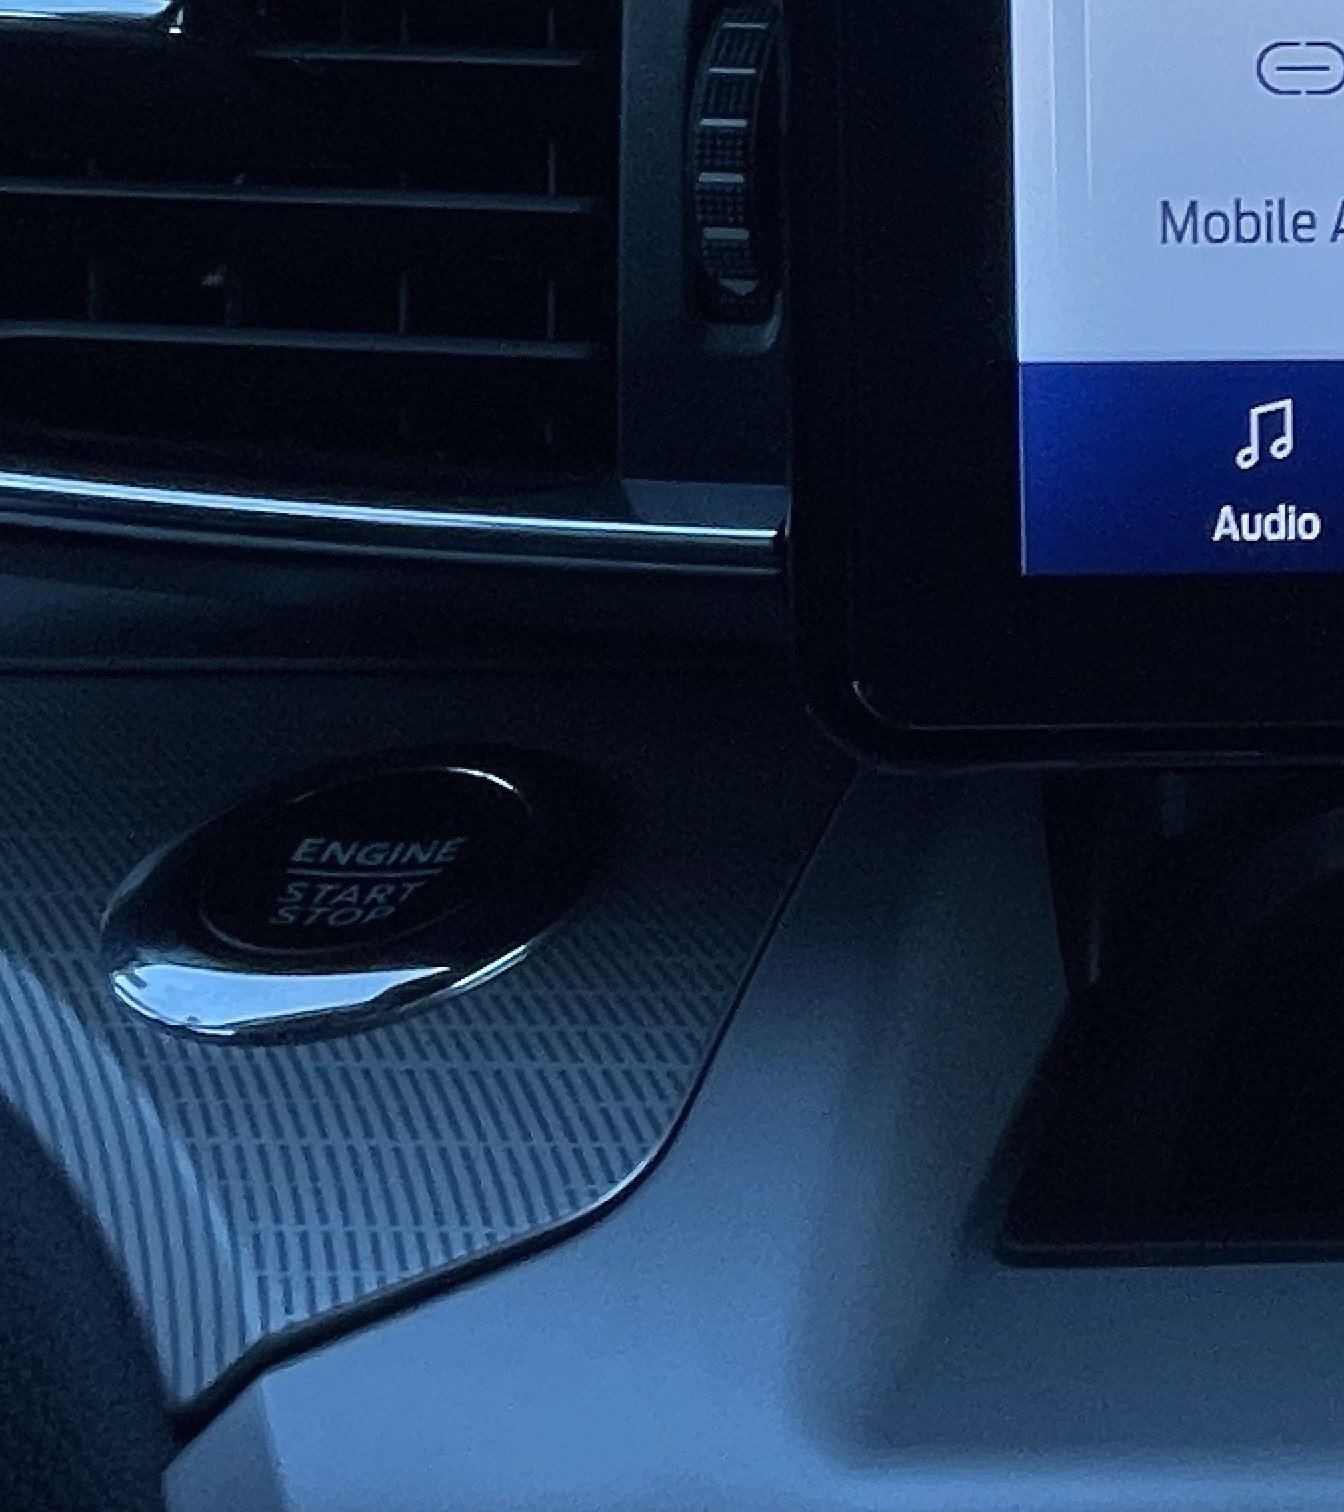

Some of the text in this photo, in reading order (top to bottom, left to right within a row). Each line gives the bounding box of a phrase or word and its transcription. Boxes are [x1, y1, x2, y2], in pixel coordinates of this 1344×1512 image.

[1160, 198, 1316, 244] Mobile
[1211, 502, 1322, 542] Audio
[291, 836, 468, 865] ENGINE
[278, 880, 428, 904] START
[268, 905, 398, 927] STOP
